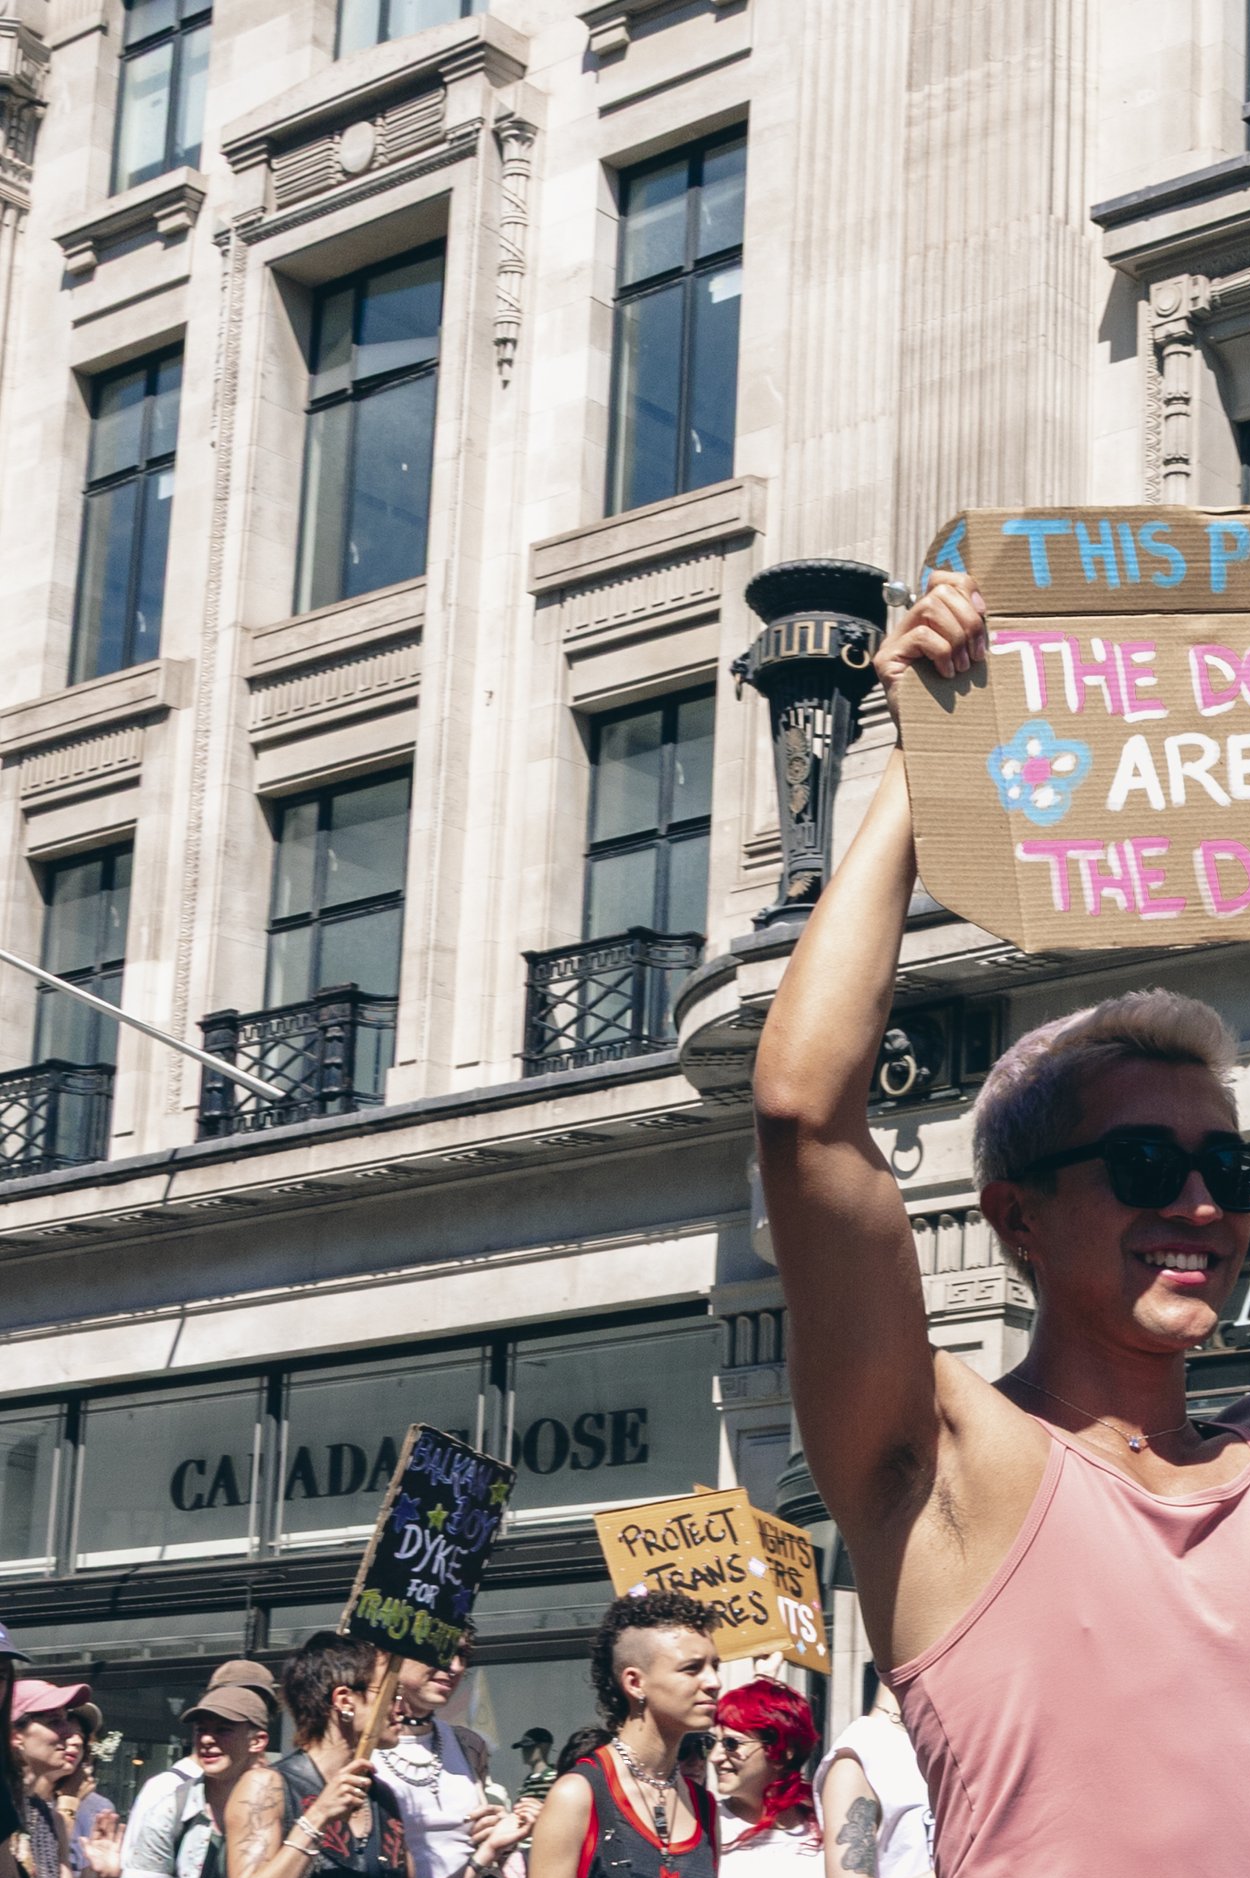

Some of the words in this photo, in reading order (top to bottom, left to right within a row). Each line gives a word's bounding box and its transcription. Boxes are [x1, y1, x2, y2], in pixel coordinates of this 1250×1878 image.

[1002, 517, 1187, 591] THIS
[990, 630, 1168, 721] THE
[1014, 835, 1187, 920] THE
[395, 1524, 465, 1586] DYKE
[618, 1507, 740, 1558] PROTECT
[406, 1579, 440, 1610] FOR
[643, 1553, 747, 1592] TRANS
